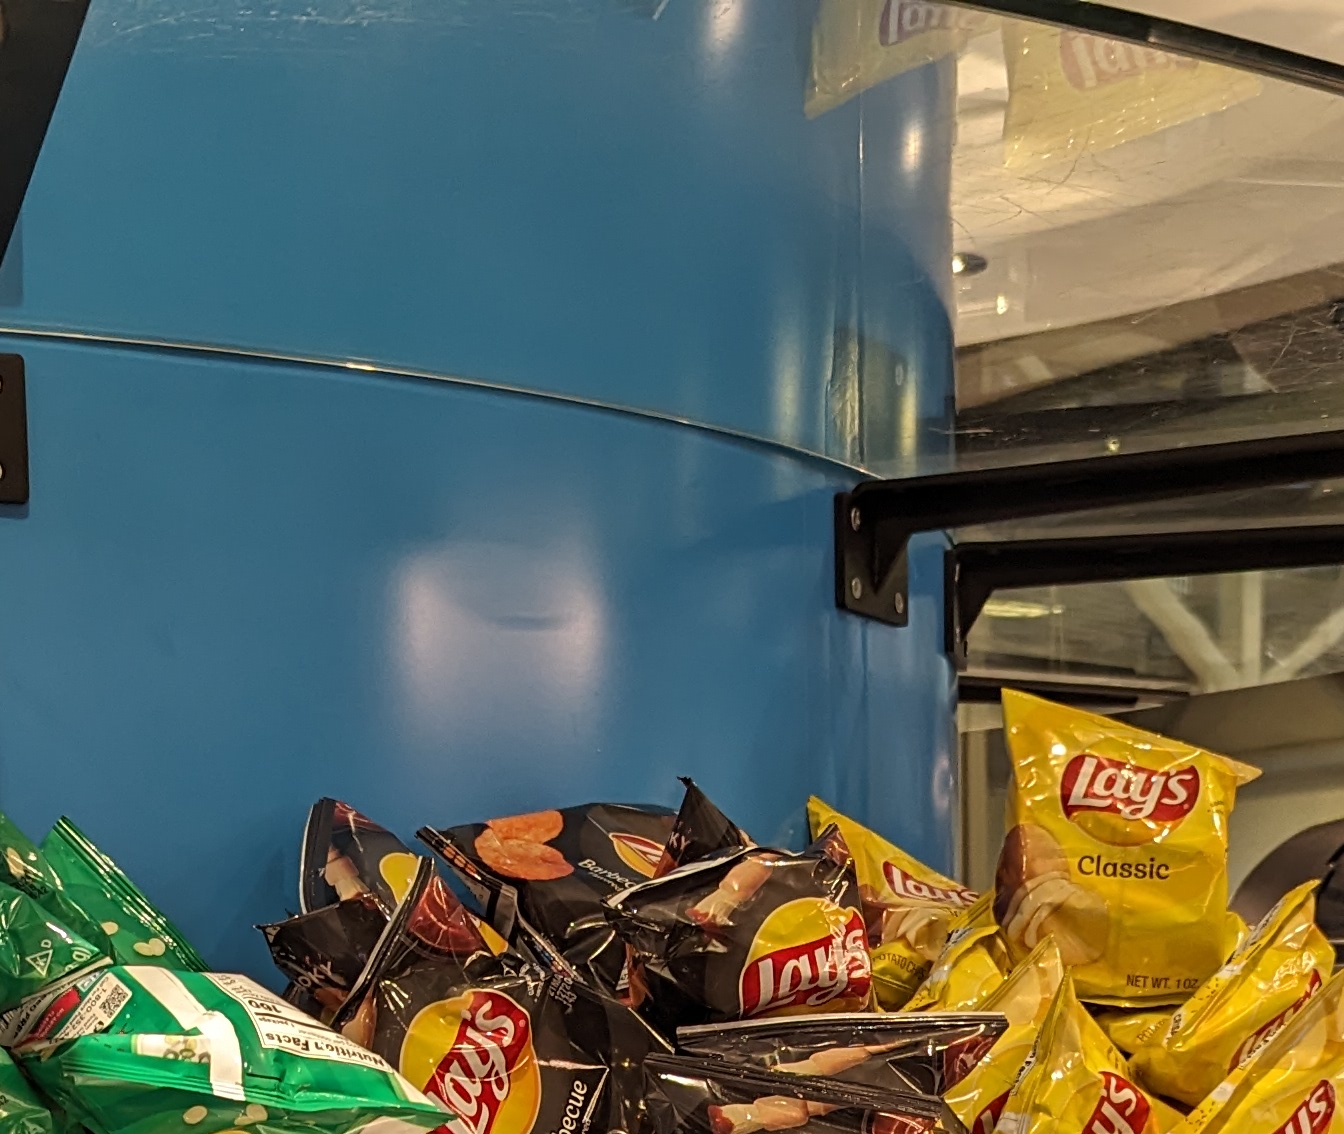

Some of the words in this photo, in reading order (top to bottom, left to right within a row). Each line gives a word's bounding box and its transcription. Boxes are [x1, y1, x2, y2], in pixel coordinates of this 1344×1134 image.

[1067, 757, 1194, 820] Lay's
[577, 858, 638, 891] Barbec
[1078, 854, 1170, 880] Classic
[1126, 974, 1148, 989] NET
[1149, 975, 1171, 990] WT.
[1175, 978, 1181, 990] 1
[266, 1032, 310, 1052] Facts
